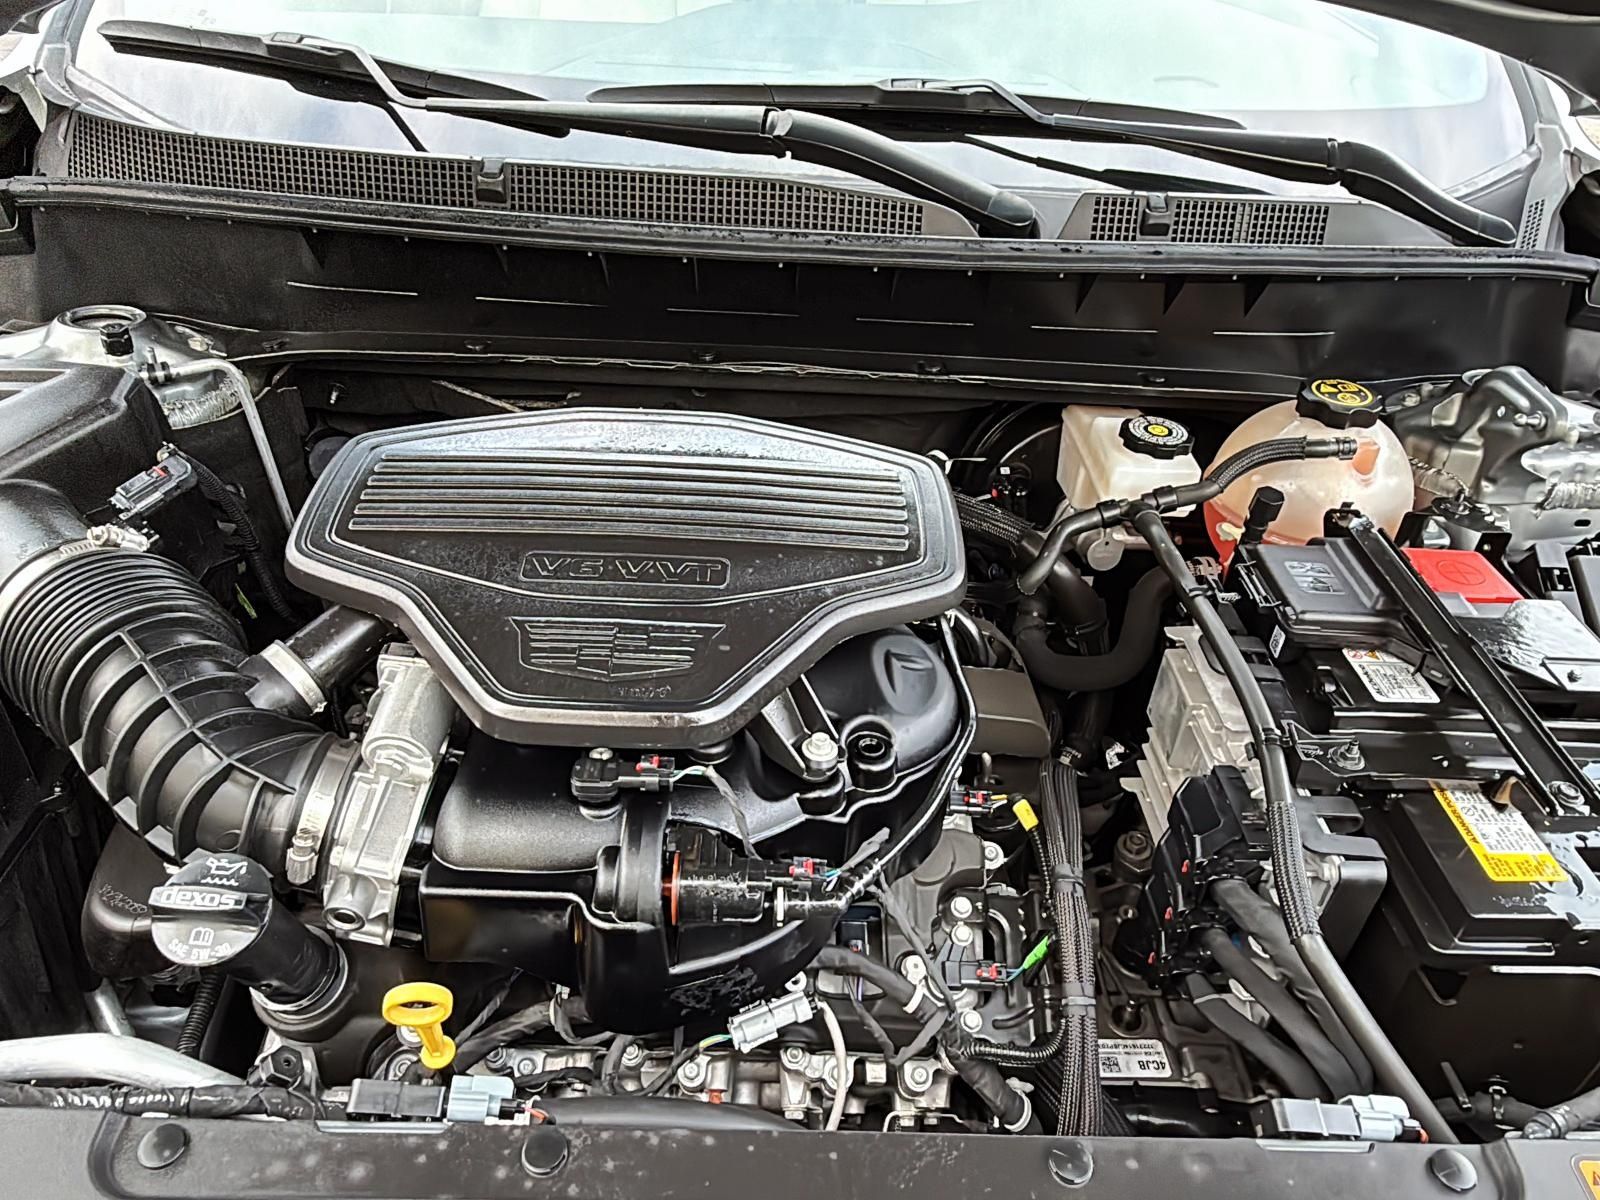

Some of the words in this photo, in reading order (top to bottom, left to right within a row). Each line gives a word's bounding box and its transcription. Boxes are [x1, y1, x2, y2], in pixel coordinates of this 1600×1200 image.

[532, 557, 604, 577] V6
[160, 886, 240, 909] dexos
[168, 938, 190, 958] SAE
[190, 942, 232, 960] 5W-30
[1137, 1060, 1166, 1071] 4CJB
